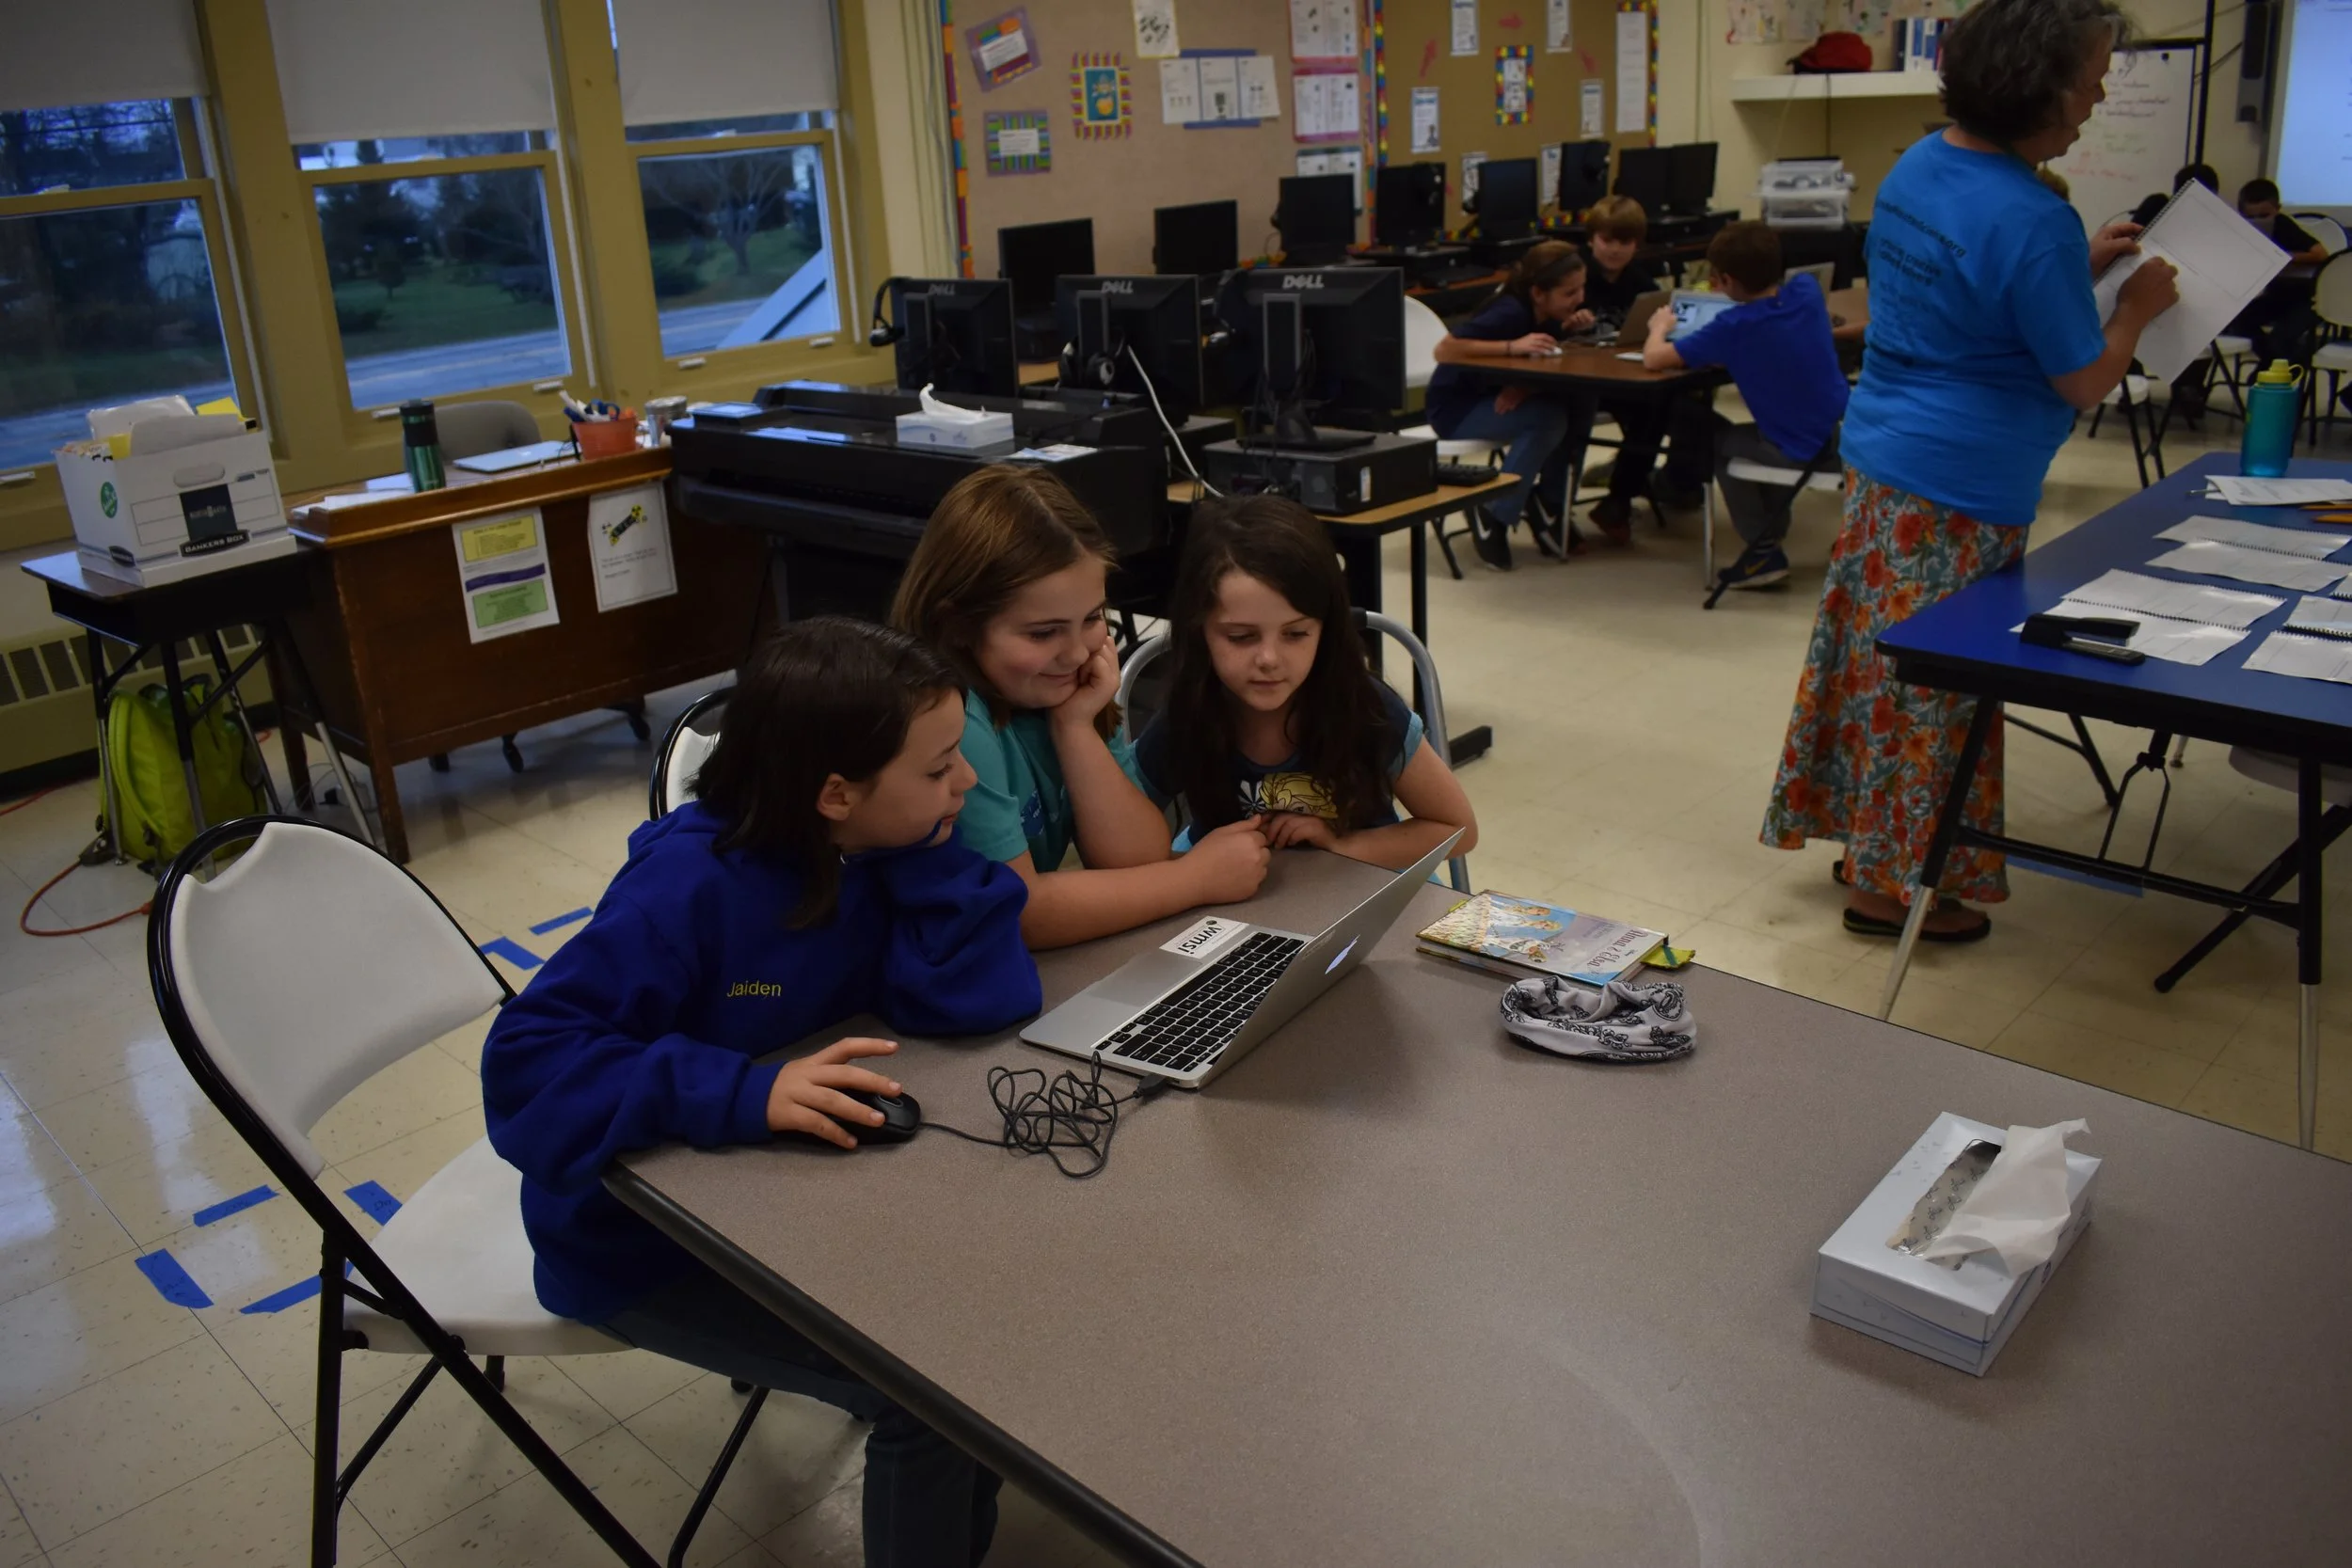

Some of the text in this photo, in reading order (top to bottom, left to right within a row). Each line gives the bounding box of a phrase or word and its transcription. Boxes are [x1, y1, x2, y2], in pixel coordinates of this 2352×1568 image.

[928, 283, 956, 295] DELL
[1100, 280, 1134, 294] DELL
[1281, 274, 1325, 290] DELL
[184, 533, 245, 553] BANKERS BOX
[1177, 927, 1222, 955] wmsi
[726, 980, 782, 997] Jaiden
